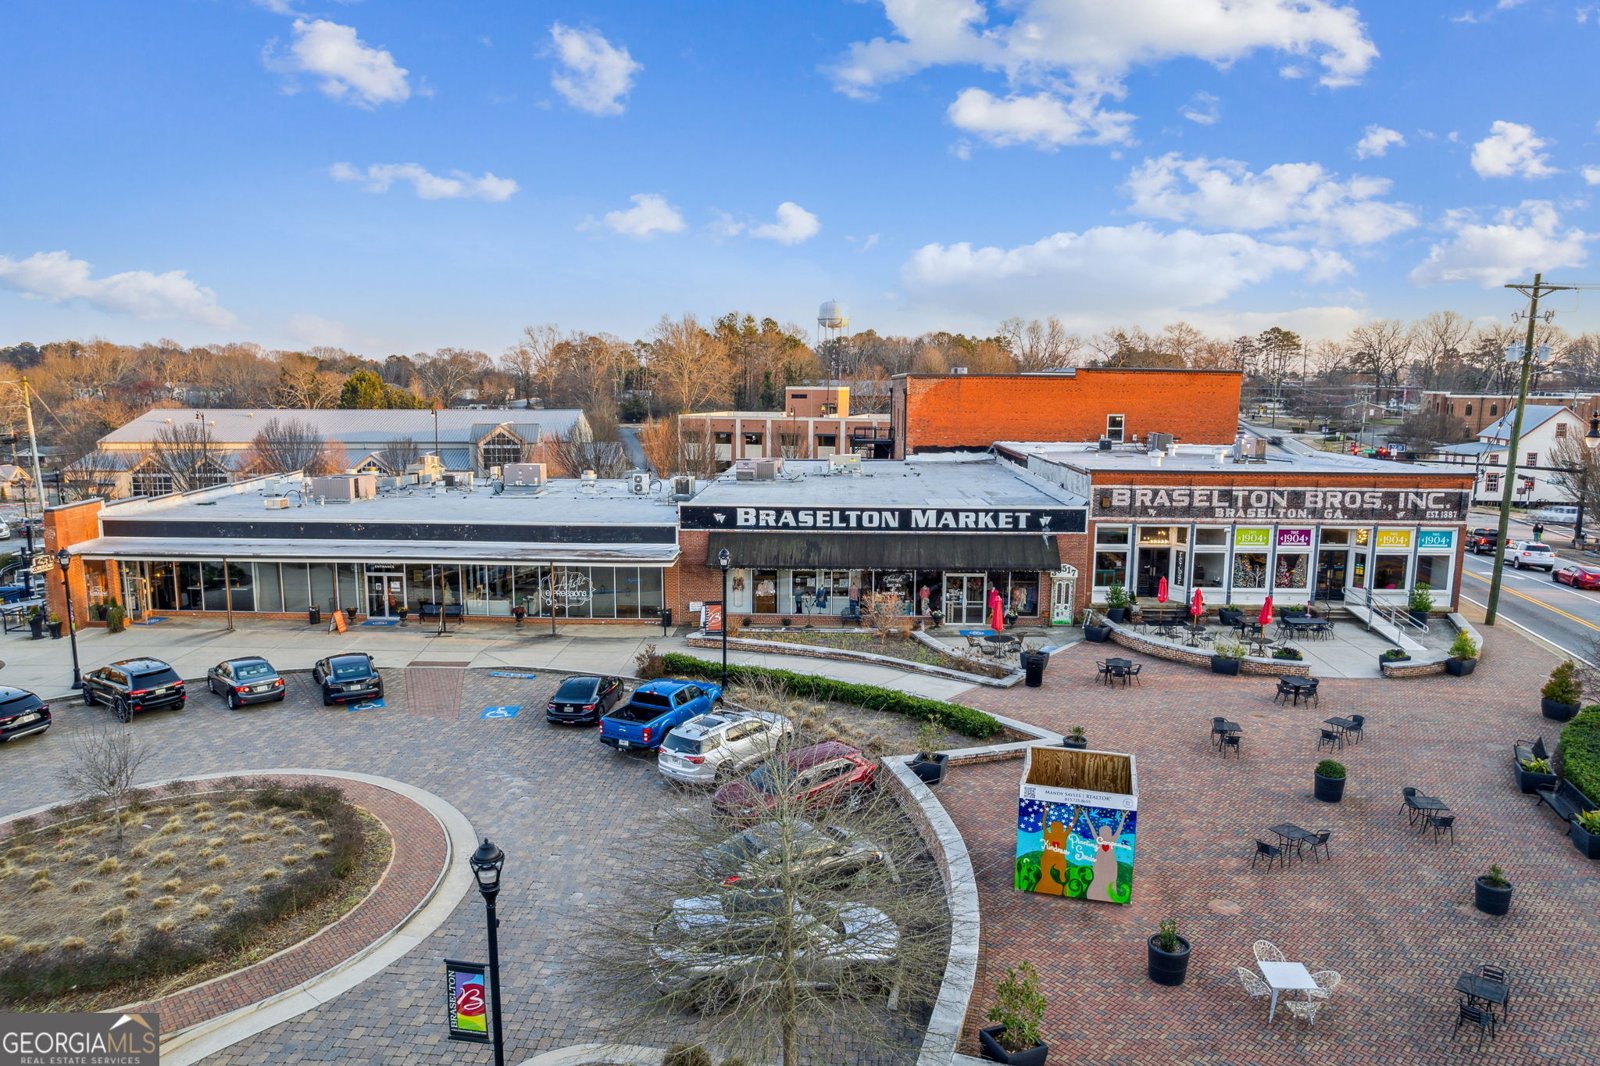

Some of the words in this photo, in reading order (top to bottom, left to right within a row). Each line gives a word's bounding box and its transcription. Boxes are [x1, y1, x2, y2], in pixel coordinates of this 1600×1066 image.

[1111, 489, 1288, 509] BRASELTON
[1304, 491, 1393, 511] BROS.,
[1399, 492, 1451, 510] INC.
[735, 507, 899, 528] BRASELTON
[910, 509, 1031, 529] MARKET
[1214, 508, 1312, 519] BRASELTON,
[1323, 509, 1348, 519] GA.
[1425, 510, 1439, 519] EST.
[1440, 511, 1458, 519] 1887
[1241, 533, 1263, 542] 1904
[1283, 534, 1305, 543] 1904
[1382, 535, 1405, 543] 1904
[1425, 536, 1446, 544] 1904
[447, 970, 458, 1028] BRASELTON
